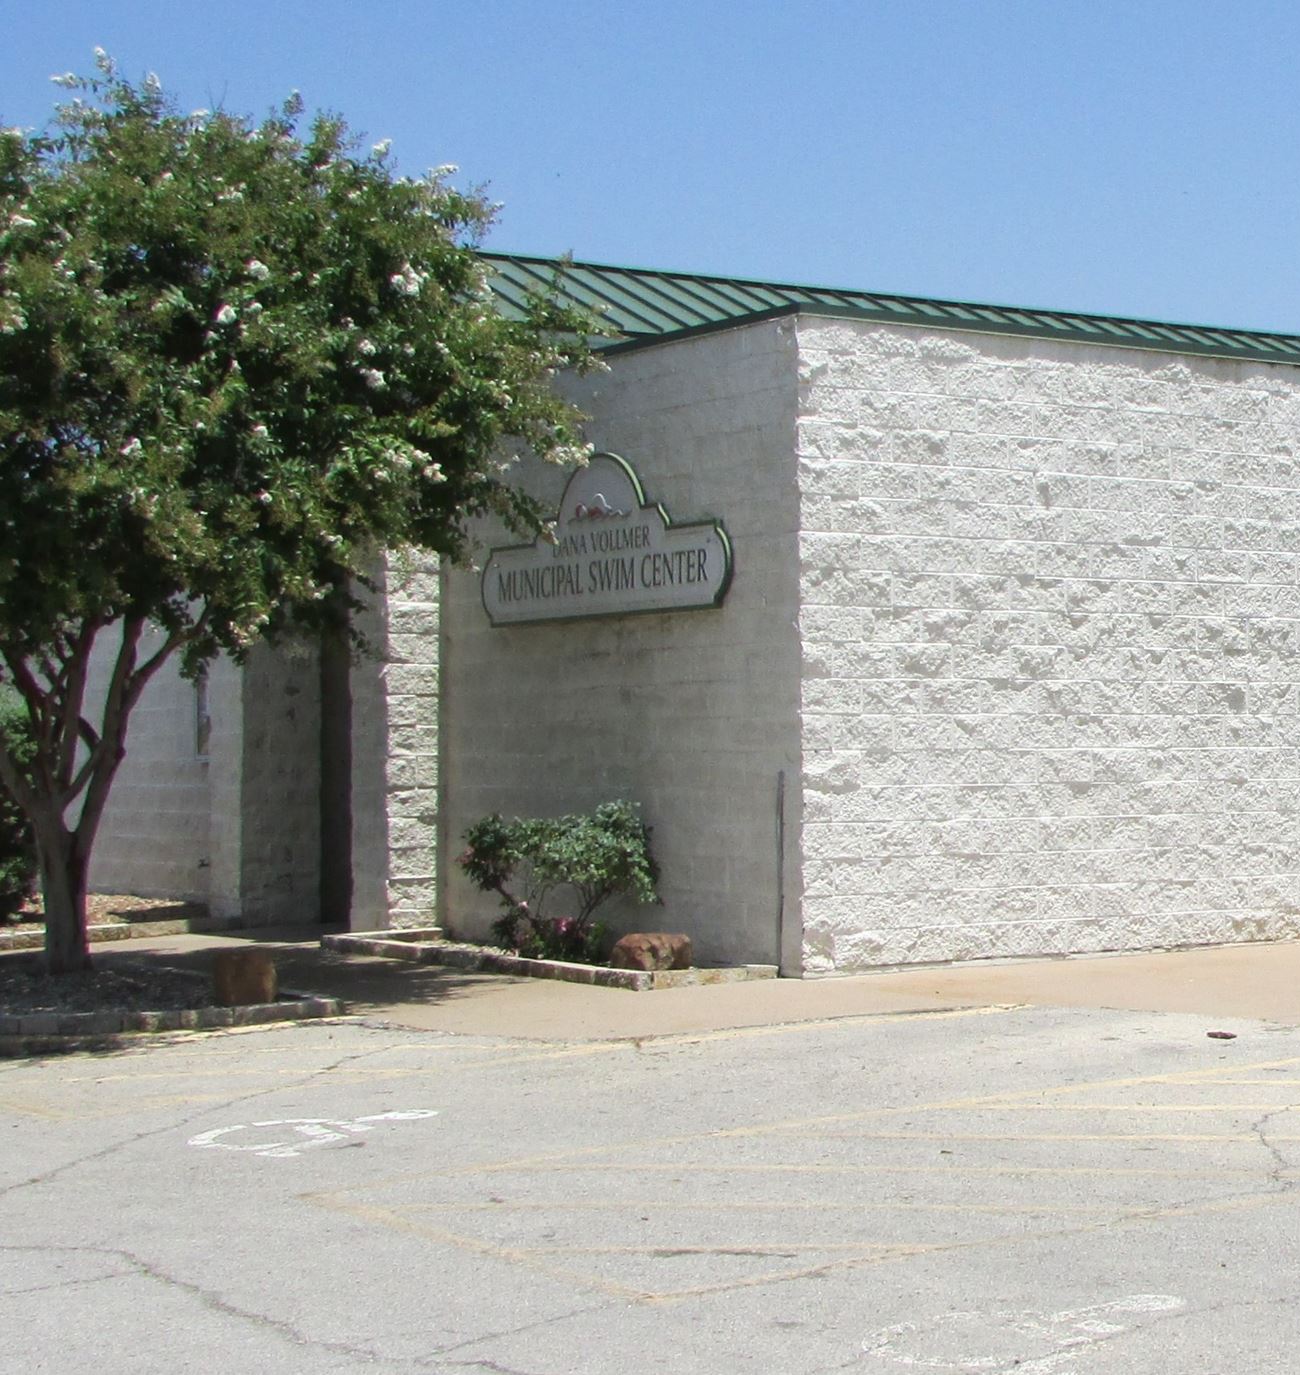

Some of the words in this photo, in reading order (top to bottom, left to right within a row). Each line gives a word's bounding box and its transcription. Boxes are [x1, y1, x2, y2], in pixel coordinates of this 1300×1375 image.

[590, 526, 650, 552] VOLLMER
[498, 564, 583, 601] MUNICIPAL
[588, 557, 635, 594] SWIM
[640, 549, 708, 588] CENTER
